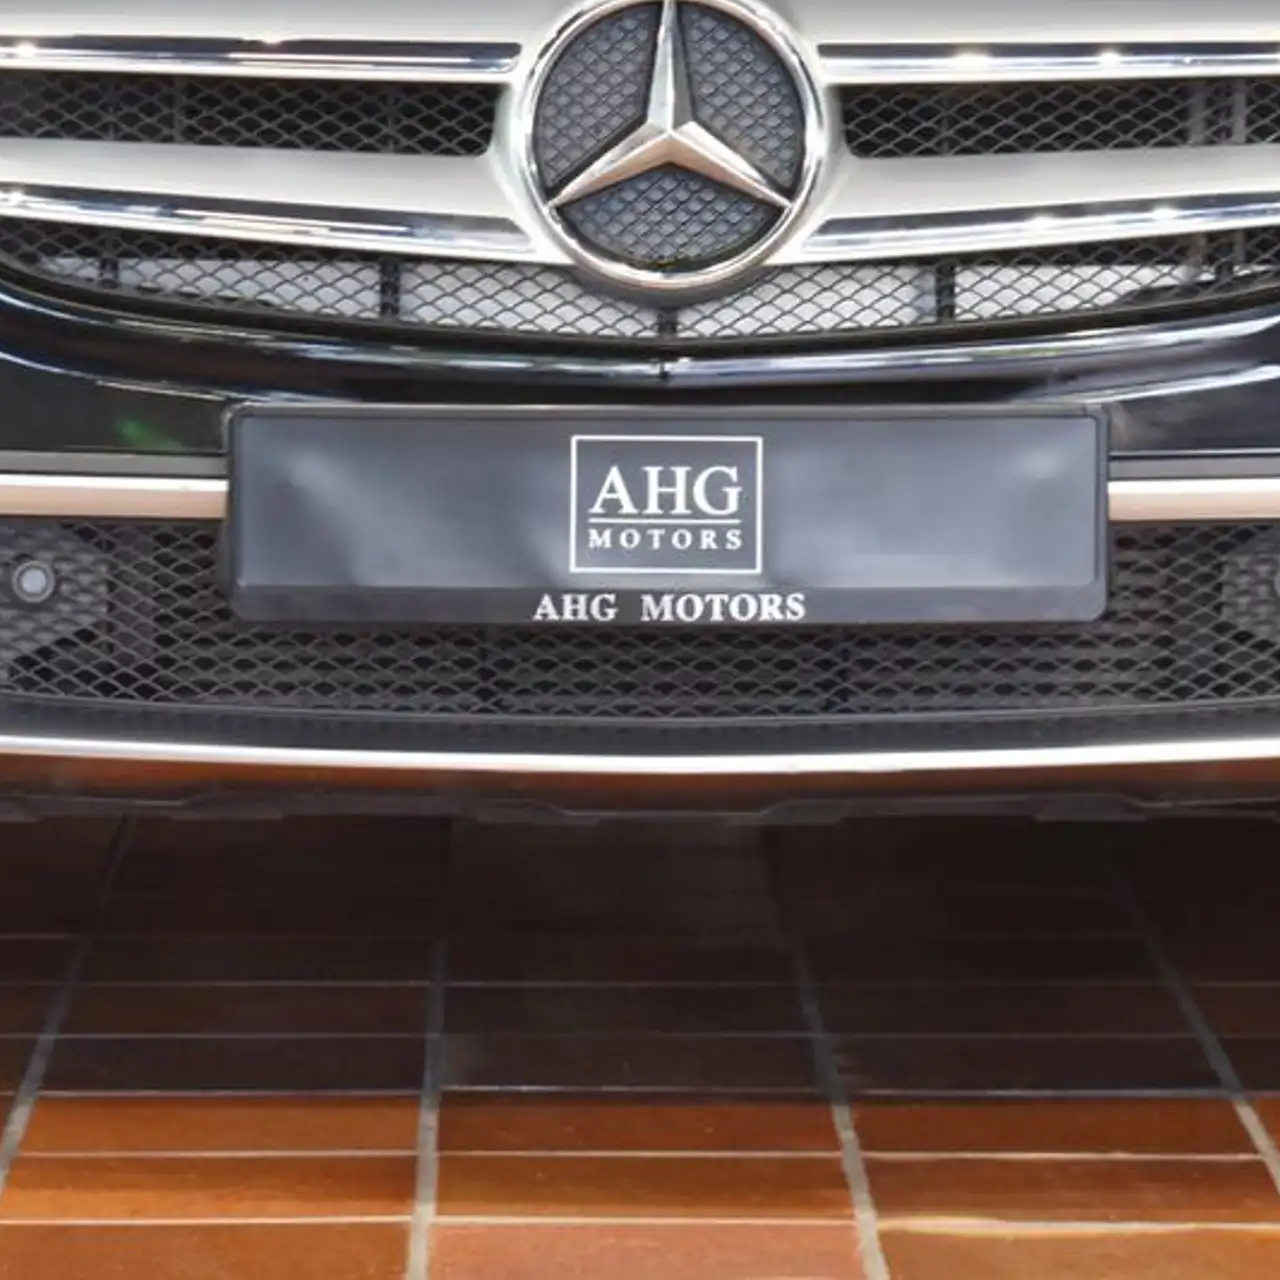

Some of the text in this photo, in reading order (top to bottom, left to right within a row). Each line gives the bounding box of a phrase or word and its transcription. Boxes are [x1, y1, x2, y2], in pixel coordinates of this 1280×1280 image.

[588, 465, 744, 516] AHG
[587, 528, 744, 550] MOTORS
[532, 592, 807, 623] AHG MOTORS
